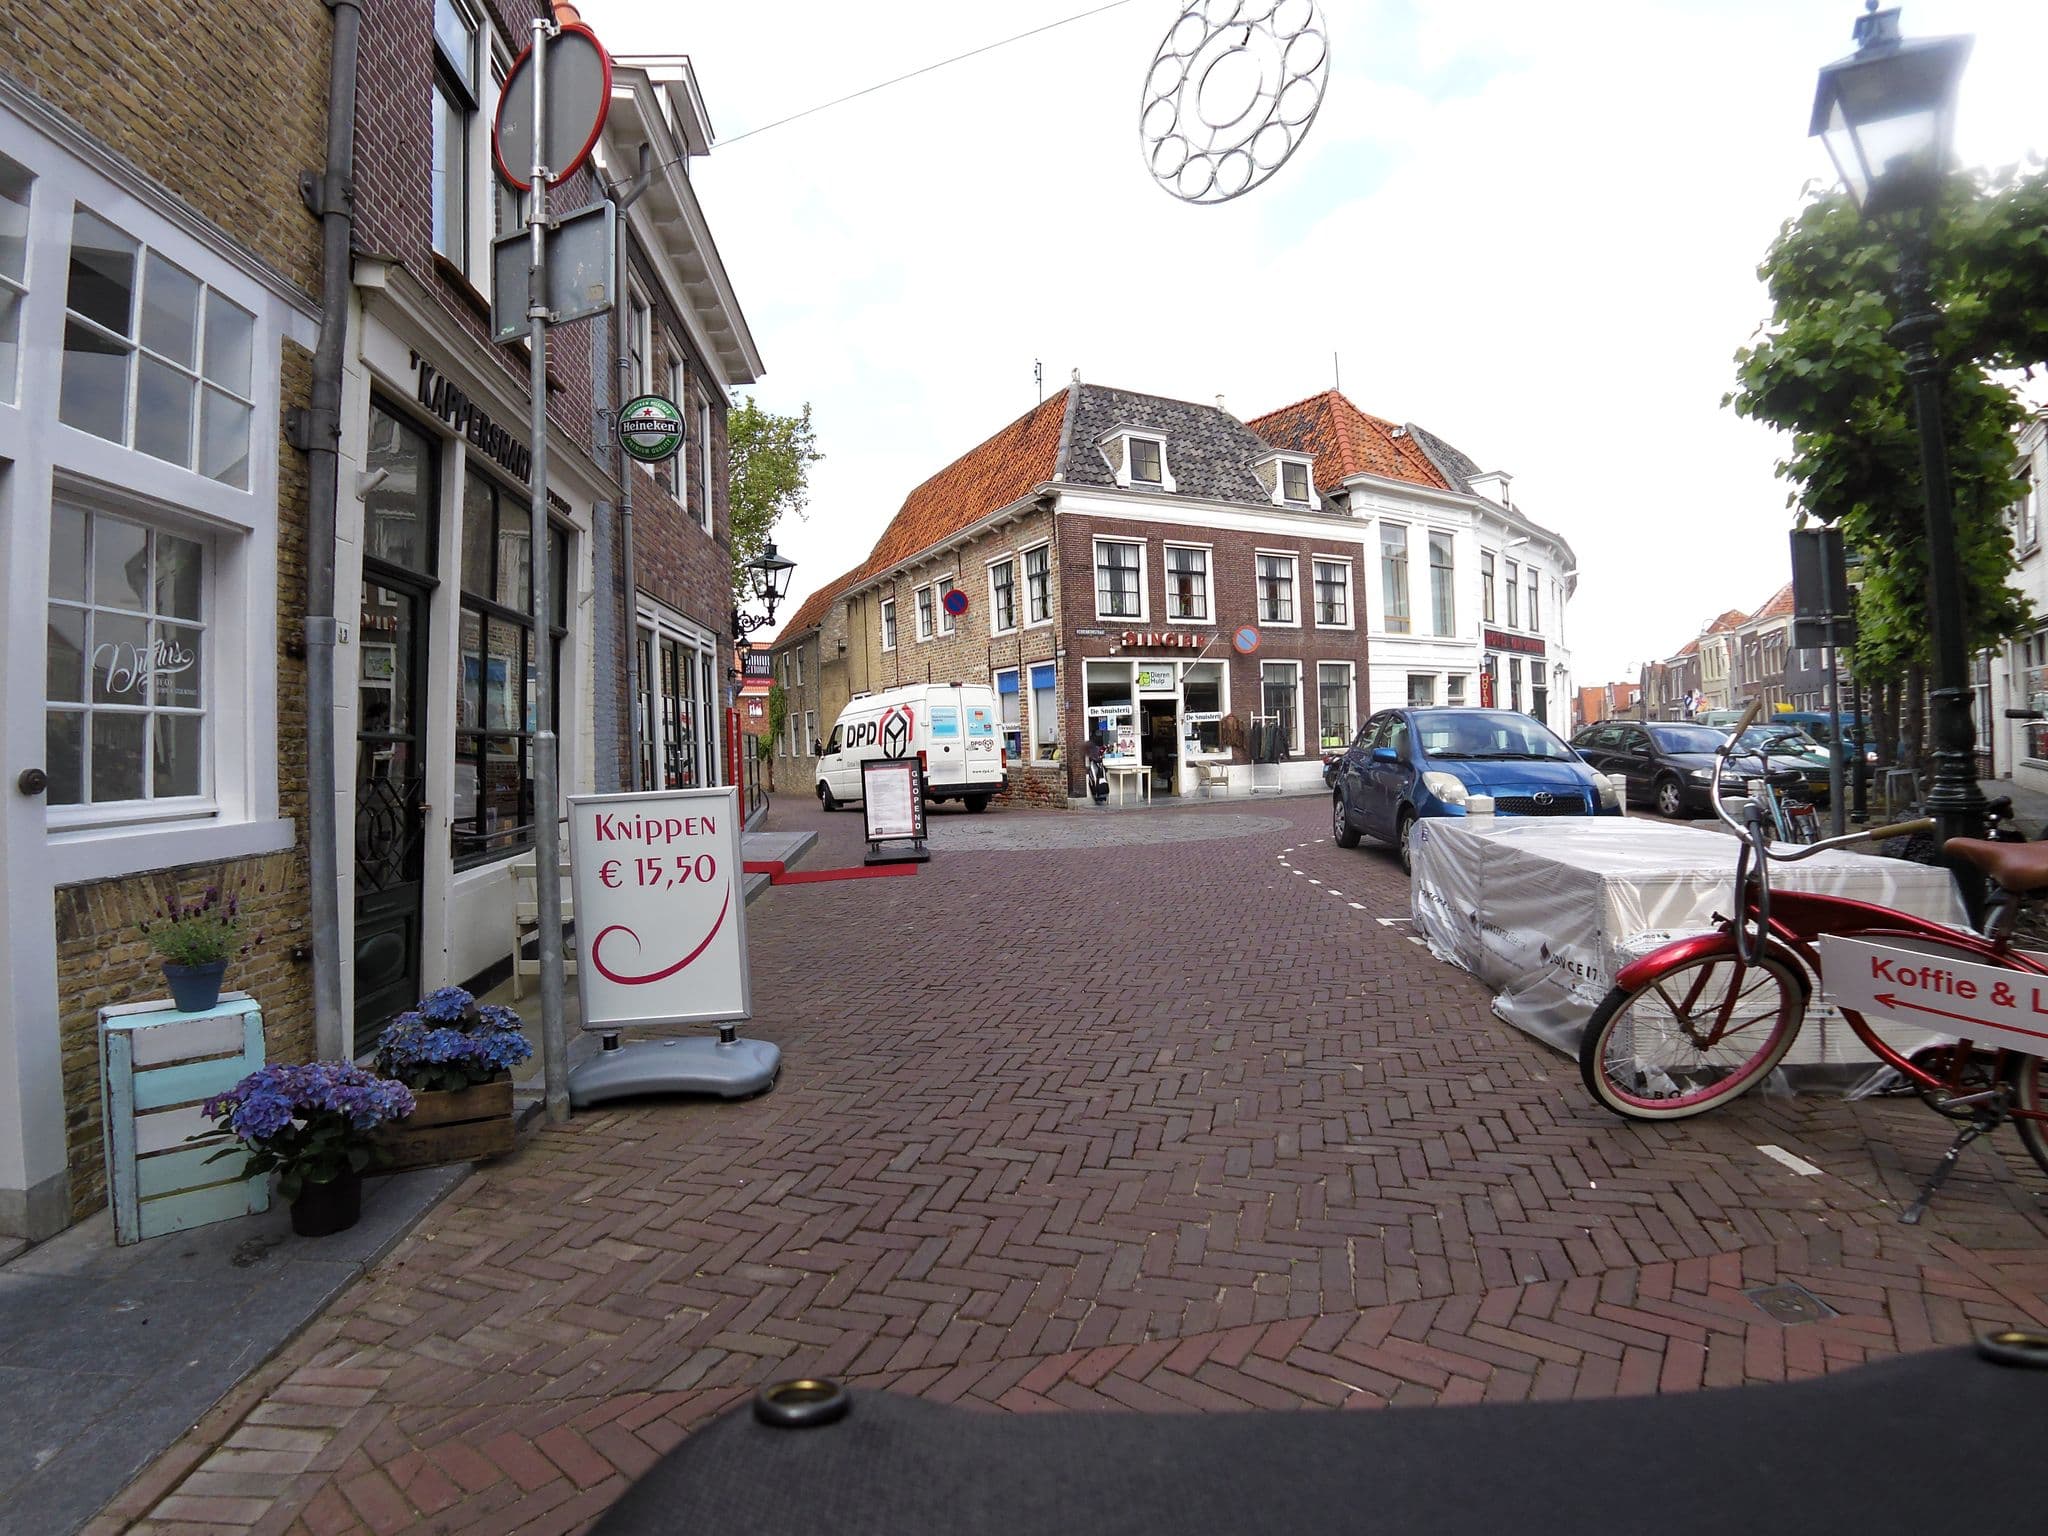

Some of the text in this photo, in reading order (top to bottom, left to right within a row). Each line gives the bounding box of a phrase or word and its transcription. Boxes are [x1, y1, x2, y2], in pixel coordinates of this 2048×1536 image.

[623, 420, 676, 432] Heineken
[1121, 630, 1207, 648] SINGER
[1150, 671, 1170, 679] Dieren
[1150, 678, 1166, 686] Hulp
[1090, 707, 1100, 715] De
[846, 721, 877, 749] DPD
[598, 853, 717, 892] € 15,50
[1870, 955, 1979, 1000] Koffie
[1989, 980, 2017, 1009] &
